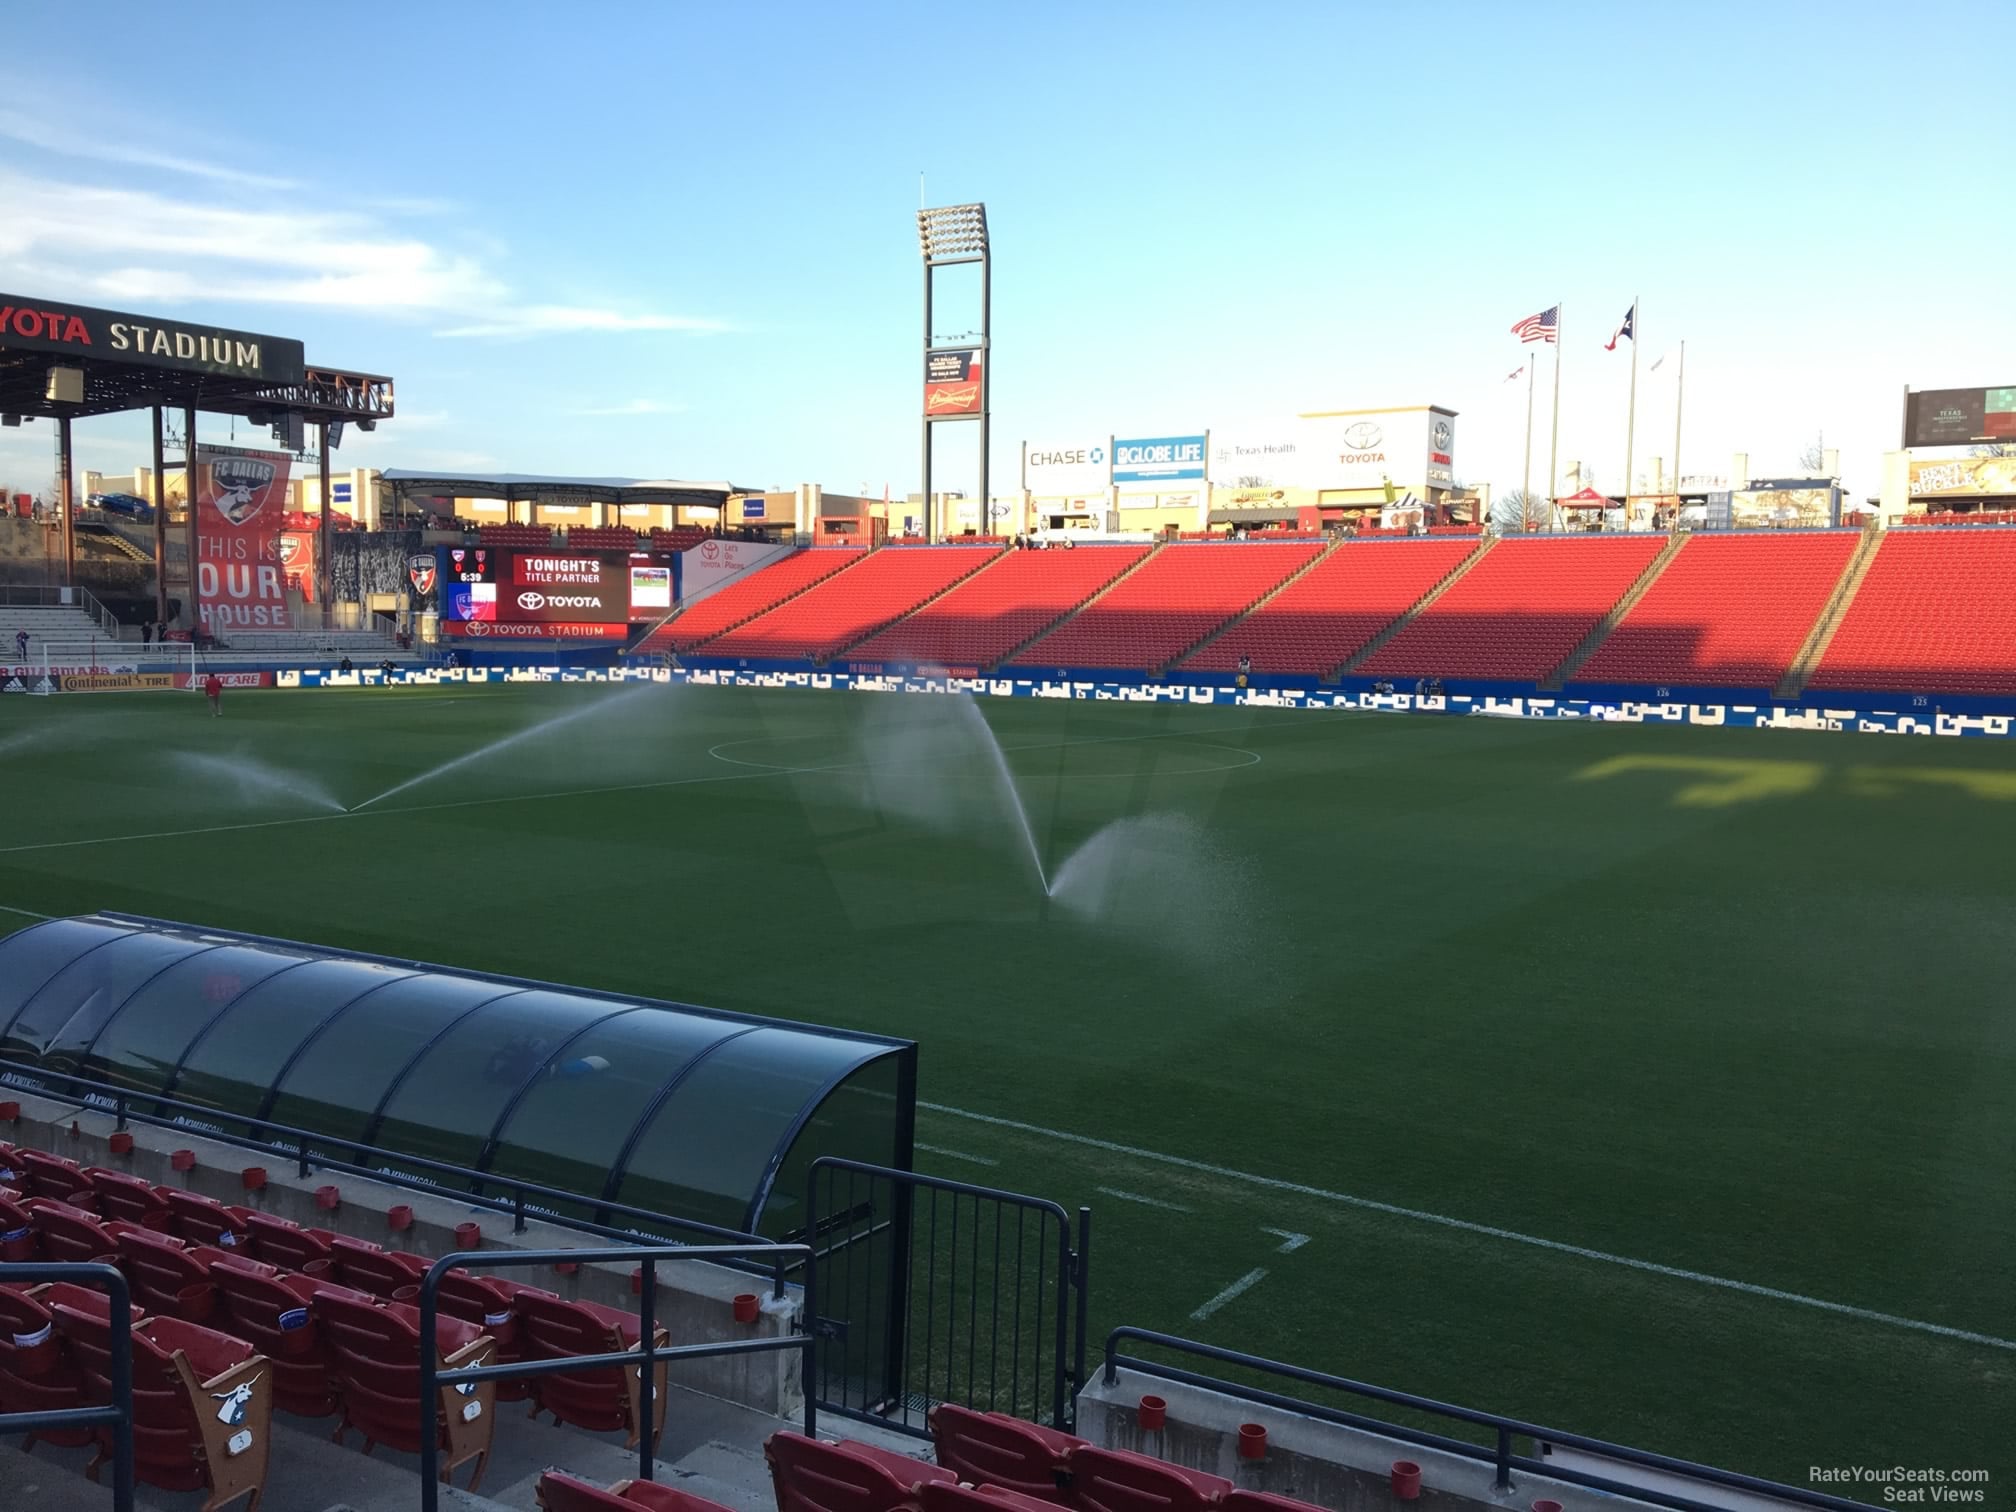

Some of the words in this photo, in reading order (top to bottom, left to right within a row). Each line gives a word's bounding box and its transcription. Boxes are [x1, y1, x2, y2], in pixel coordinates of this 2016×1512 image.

[110, 323, 259, 369] STADIUM
[1127, 445, 1172, 464] GLOBE
[1174, 444, 1201, 462] LIFE
[1235, 446, 1261, 456] Texas
[1263, 443, 1296, 454] Health
[1030, 450, 1086, 466] CHASE
[1340, 453, 1386, 464] TOYOTA
[215, 461, 229, 476] FC
[232, 462, 271, 481] DALLAS
[197, 536, 247, 559] THIS
[259, 537, 277, 561] IS
[455, 563, 462, 572] 0
[478, 563, 485, 572] 0
[524, 558, 600, 572] TONIGHT'S
[198, 562, 282, 599] OUR
[525, 573, 552, 582] TITLE
[555, 573, 600, 583] PARTNER
[546, 596, 602, 608] TOYOTA
[200, 604, 286, 625] HOUSE
[492, 625, 542, 635] TOYOTA
[548, 625, 604, 636] STADIUM
[64, 675, 132, 691] Continental
[144, 677, 169, 686] TIRE
[1912, 698, 1928, 706] 125
[469, 1405, 476, 1416] 2
[237, 1435, 244, 1449] 3
